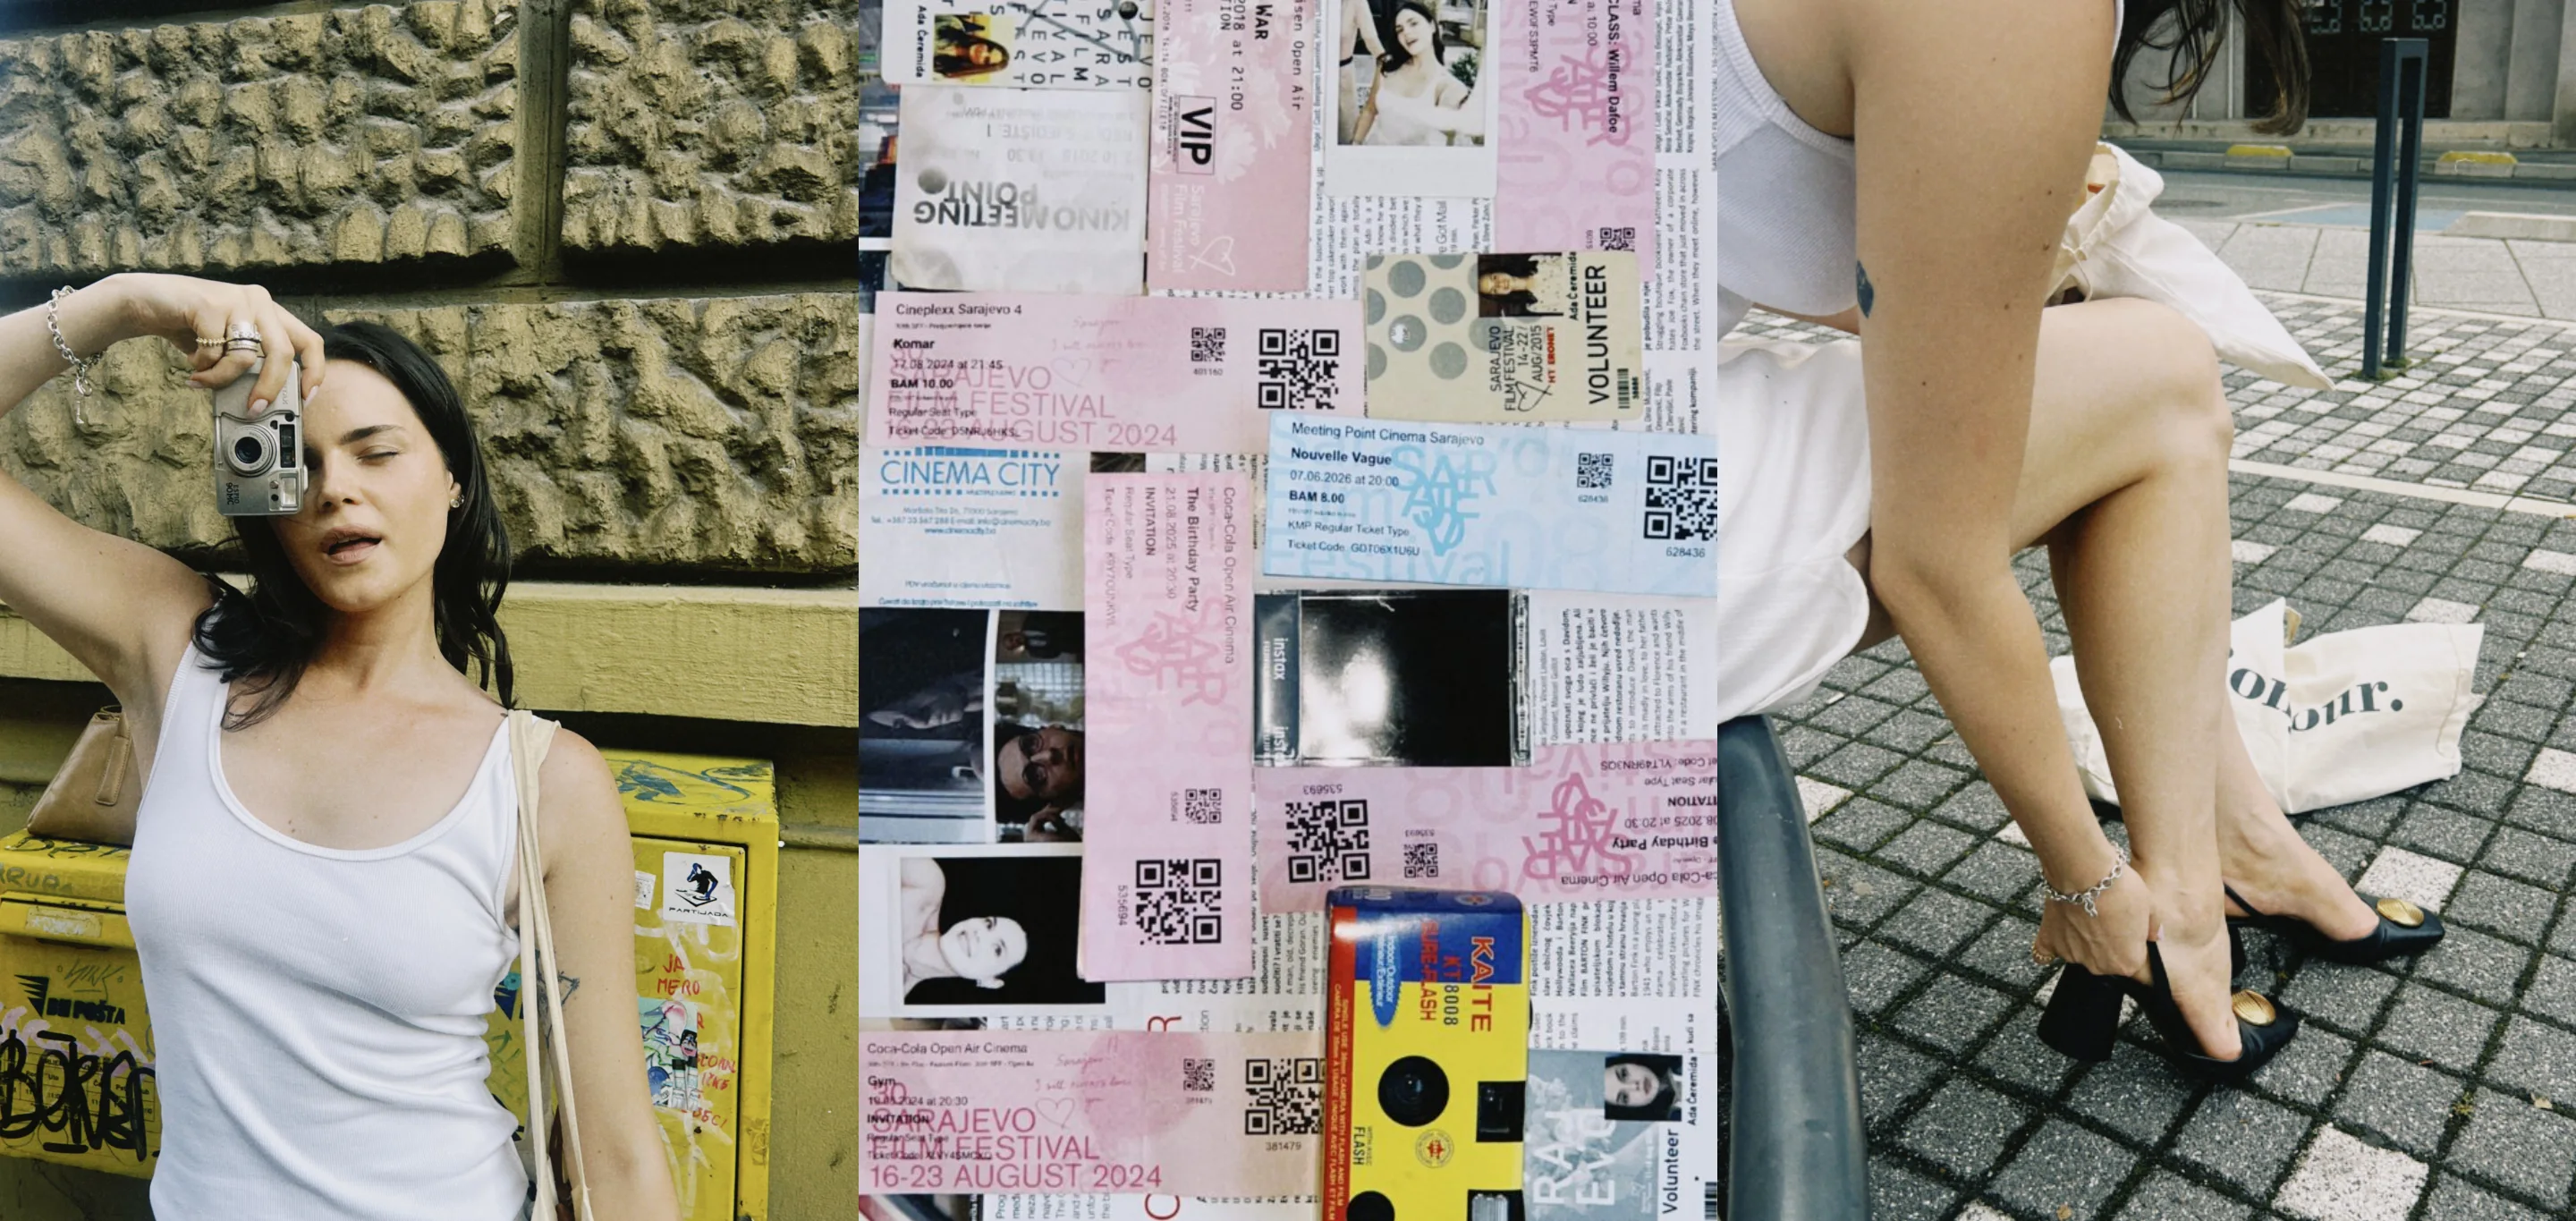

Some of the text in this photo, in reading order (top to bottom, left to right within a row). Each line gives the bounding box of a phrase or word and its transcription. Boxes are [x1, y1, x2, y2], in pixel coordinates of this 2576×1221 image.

[1546, 4, 1557, 26] Type
[916, 6, 929, 78] Ada Čeremida
[1231, 40, 1243, 111] at 21:00
[1291, 41, 1304, 111] Open Air
[1608, 49, 1620, 92] Willem
[1608, 97, 1620, 133] Dafoe
[1181, 107, 1214, 165] VIP
[944, 182, 1038, 207] POINT
[913, 201, 1131, 231] KINO MEETING
[1436, 201, 1447, 244] Got Mail
[1566, 251, 1579, 321] Ada Čeremida
[896, 303, 1022, 317] Cineplexx Sarajevo 4
[894, 338, 936, 349] Komar
[1585, 266, 1610, 404] VOLUNTEER
[1488, 326, 1503, 392] SARAJEVO
[1517, 332, 1529, 366] 14-22
[1530, 325, 1543, 382] AUG/2015
[1504, 326, 1516, 411] FILM FESTIVAL
[891, 378, 953, 388] BAM 10.00
[970, 391, 1115, 419] FESTIVAL
[1107, 423, 1178, 447] 2024
[1292, 422, 1485, 448] Meeting Point Cinema Sarajevo
[1291, 447, 1393, 466] Nouvelle Vague
[880, 461, 1061, 487] CINEMA CITY
[1290, 470, 1400, 488] 07.06.2026 at 20:00
[225, 483, 234, 505] 90MC
[1289, 489, 1345, 504] BAM 8.00
[1145, 488, 1157, 556] INVITATION
[1288, 521, 1411, 538] KMP Regular Ticket Type
[1185, 488, 1199, 612] The Birthday Party
[1287, 539, 1317, 550] Ticket
[1665, 547, 1707, 558] 628436
[1222, 487, 1237, 665] Coca-Cola Open Air Cinema
[1273, 638, 1289, 680] instax
[1614, 649, 1623, 673] usred
[1564, 675, 1573, 699] svoga
[1564, 702, 1572, 739] upoznati
[1644, 776, 1696, 787] Seat Type
[1624, 817, 1671, 828] at 20:30
[1613, 835, 1708, 851] Birthday Party
[1561, 871, 1667, 886] Open Air Cinema
[669, 906, 729, 918] PARTIJADA
[1117, 885, 1129, 926] 535694
[1580, 916, 1589, 974] BARTON FINK
[664, 954, 685, 974] JA
[1259, 945, 1269, 995] sudbonosni
[1419, 920, 1438, 1022] SURE-FLASH
[1555, 946, 1564, 996] Hollywooda
[657, 978, 700, 996] MERO
[1442, 954, 1461, 1026] KT 8008
[1470, 936, 1496, 1032] KAITE
[1530, 979, 1538, 996] Fink
[1568, 960, 1576, 996] Wallacea
[72, 999, 126, 1025] POŠTA
[868, 1042, 1028, 1056] Coca-Cola Open Air Cinema
[868, 1076, 896, 1088] Gym
[1685, 1056, 1699, 1126] Ada Čeremida
[927, 1097, 969, 1107] at 20:30
[873, 1107, 1037, 1133] SARAJEVO
[956, 1135, 1101, 1161] FESTIVAL
[1353, 1127, 1366, 1166] FLASH
[871, 1164, 1162, 1188] 16-23 AUGUST 2024
[1663, 1129, 1680, 1214] Volunteer
